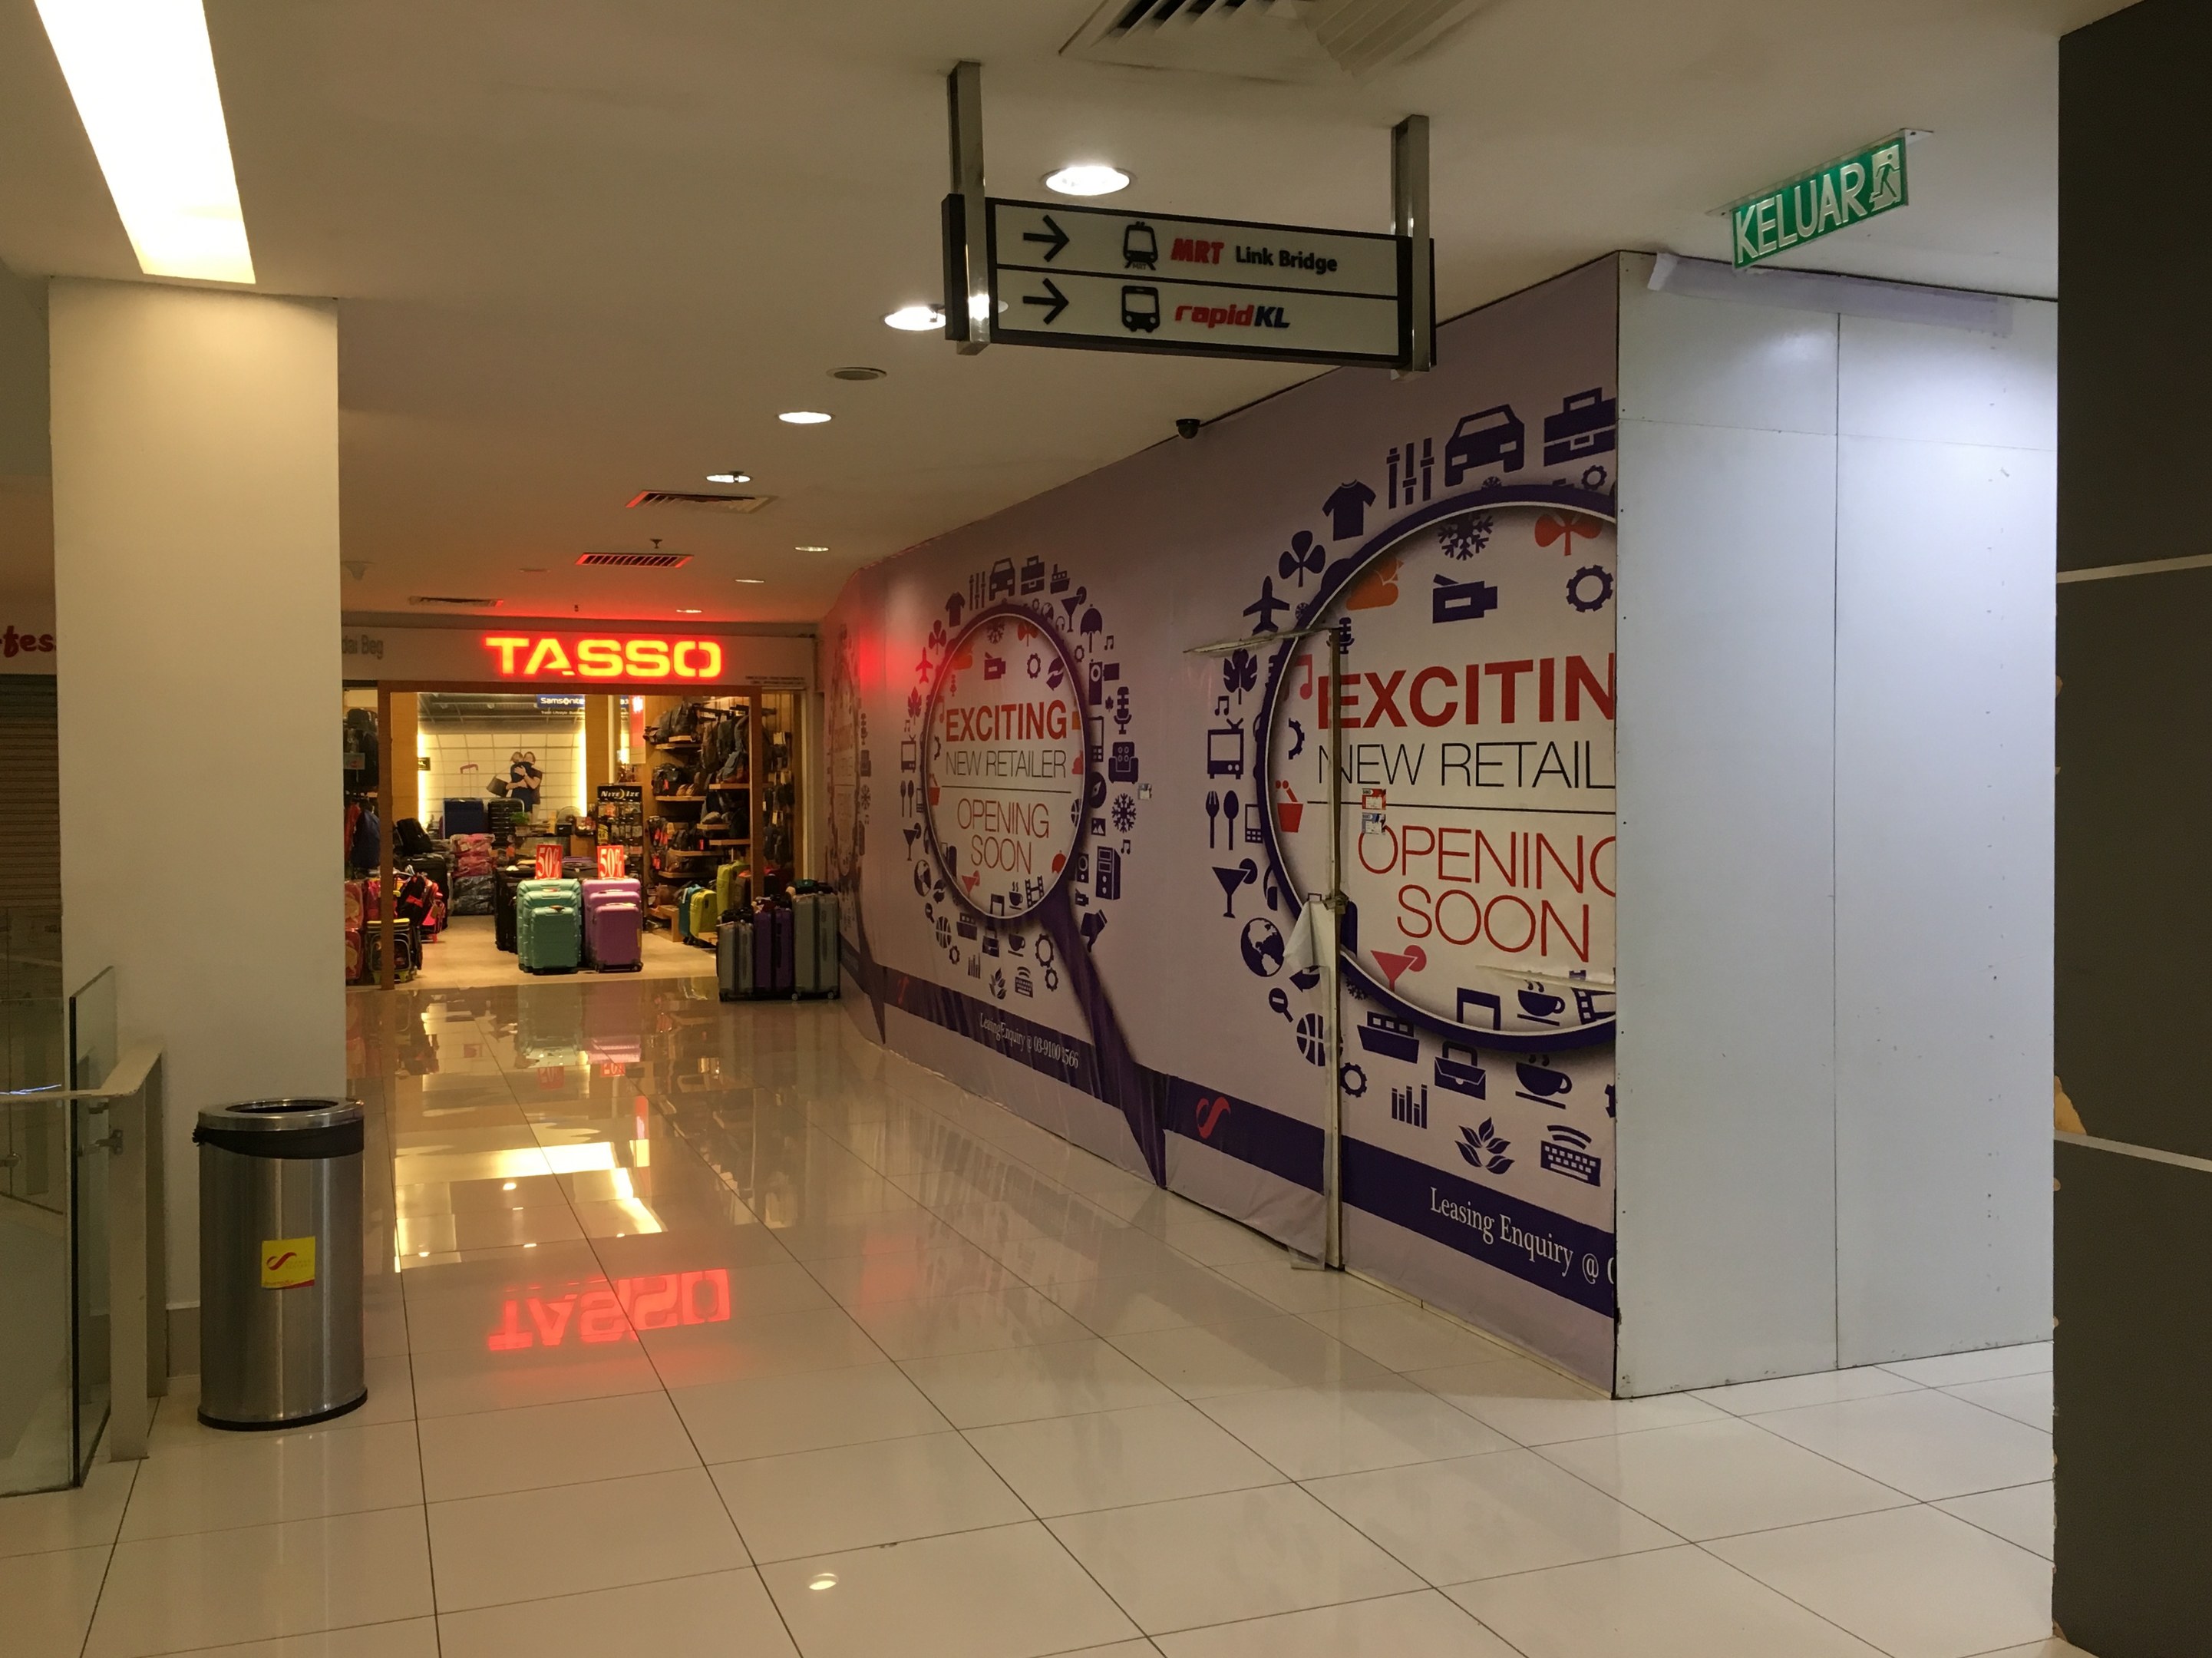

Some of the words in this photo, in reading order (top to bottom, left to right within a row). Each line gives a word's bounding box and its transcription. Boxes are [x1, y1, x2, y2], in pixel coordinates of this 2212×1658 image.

[1735, 162, 1868, 263] KELUAR
[1170, 238, 1224, 265] MRT
[1236, 246, 1274, 266] Link
[1279, 249, 1337, 275] Bridge
[1175, 304, 1291, 329] rapidKL
[362, 634, 384, 660] Beg
[484, 636, 722, 679] TASSO
[540, 697, 585, 705] Samsonite
[946, 699, 1067, 742] EXCITING
[946, 751, 982, 776] NEW
[986, 750, 1067, 778] RETAILER
[1319, 744, 1425, 785] NEW
[957, 798, 1049, 838] OPENING
[538, 847, 560, 877] 50%
[600, 848, 622, 877] 50%
[971, 834, 1032, 875] SOON
[1397, 884, 1589, 963] SOON
[1430, 1187, 1495, 1245] Leasing
[1500, 1214, 1573, 1277] Enquiry
[1582, 1253, 1600, 1285] @
